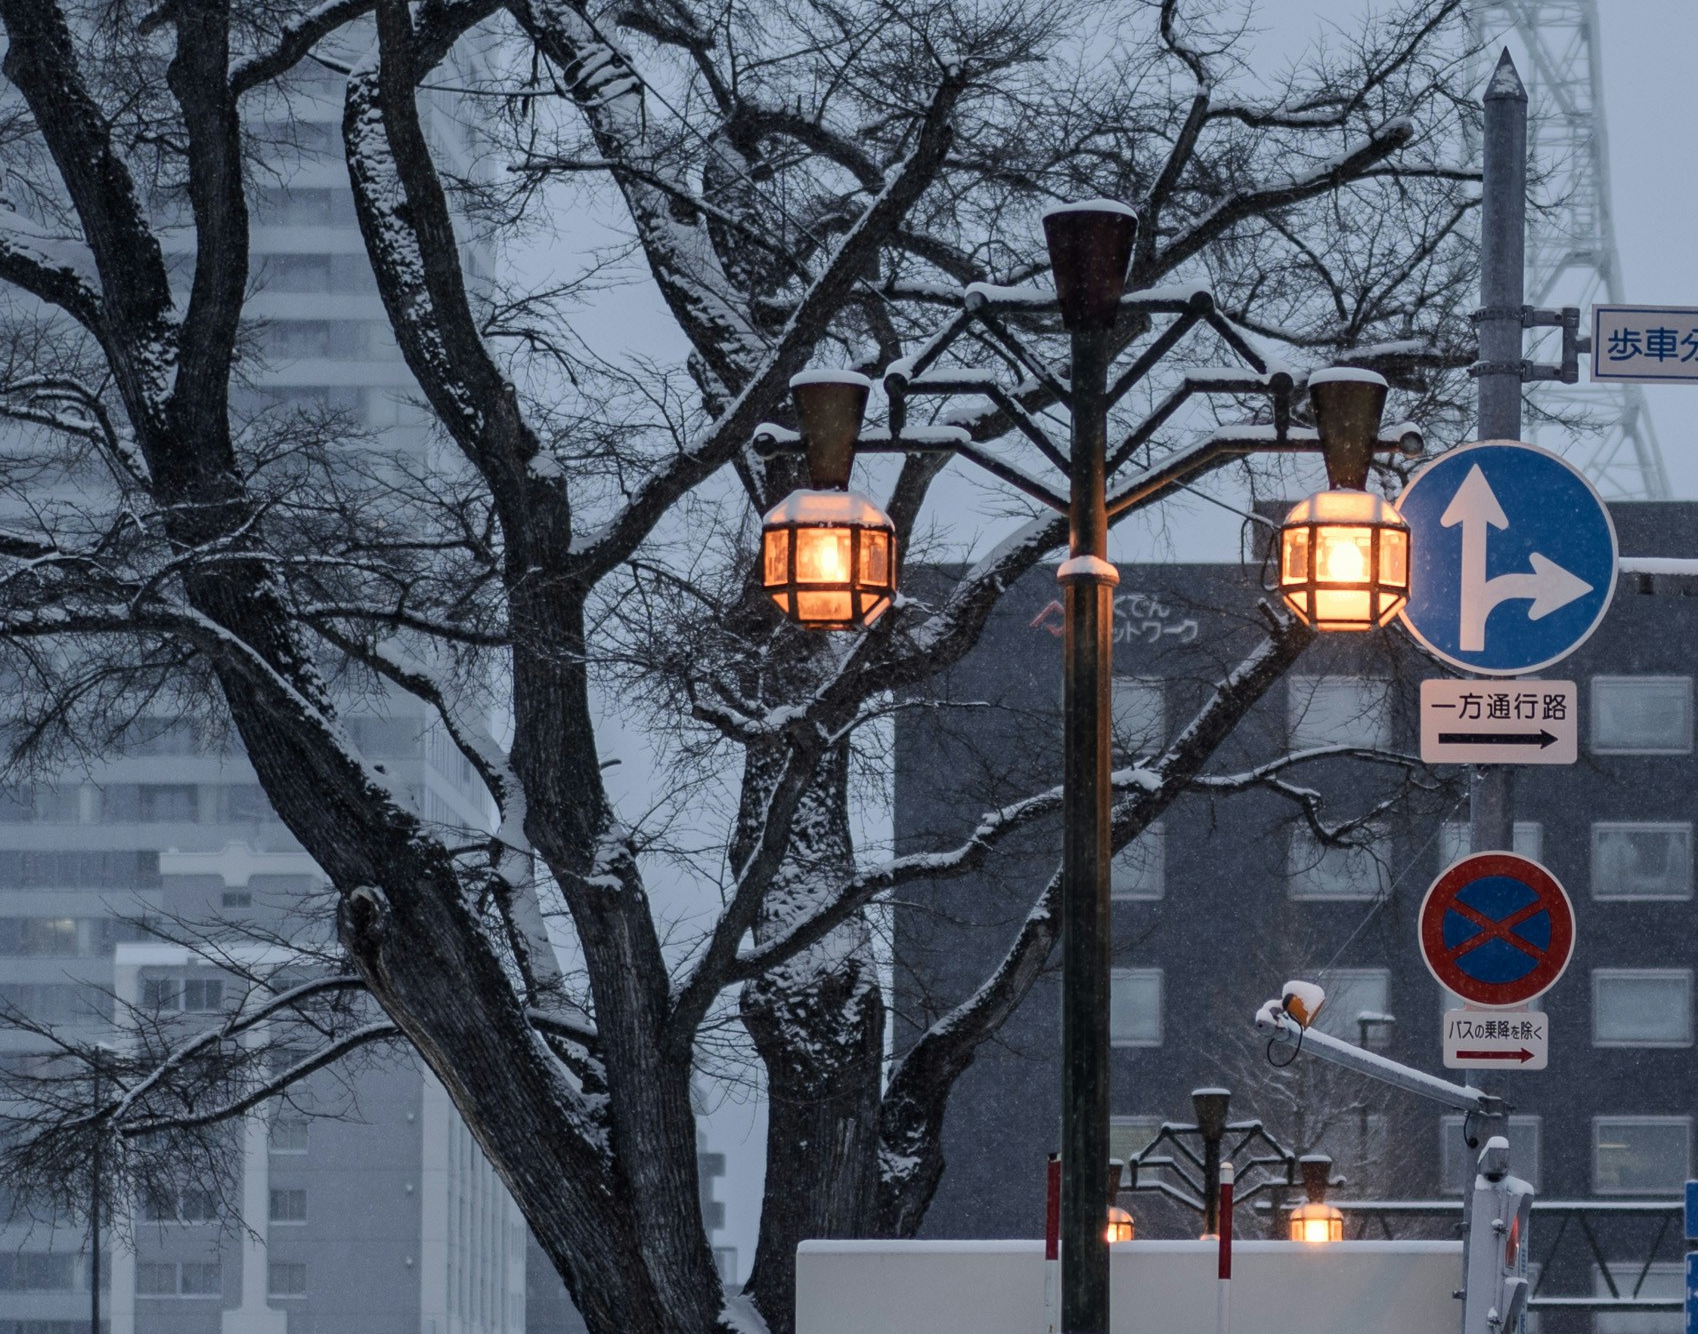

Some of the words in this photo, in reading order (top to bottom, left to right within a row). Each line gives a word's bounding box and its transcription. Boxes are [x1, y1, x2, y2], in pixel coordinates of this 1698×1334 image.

[1112, 595, 1170, 618] くでん
[1430, 692, 1567, 721] 一方通行路
[1448, 1020, 1543, 1041] バスの乗降を除く
